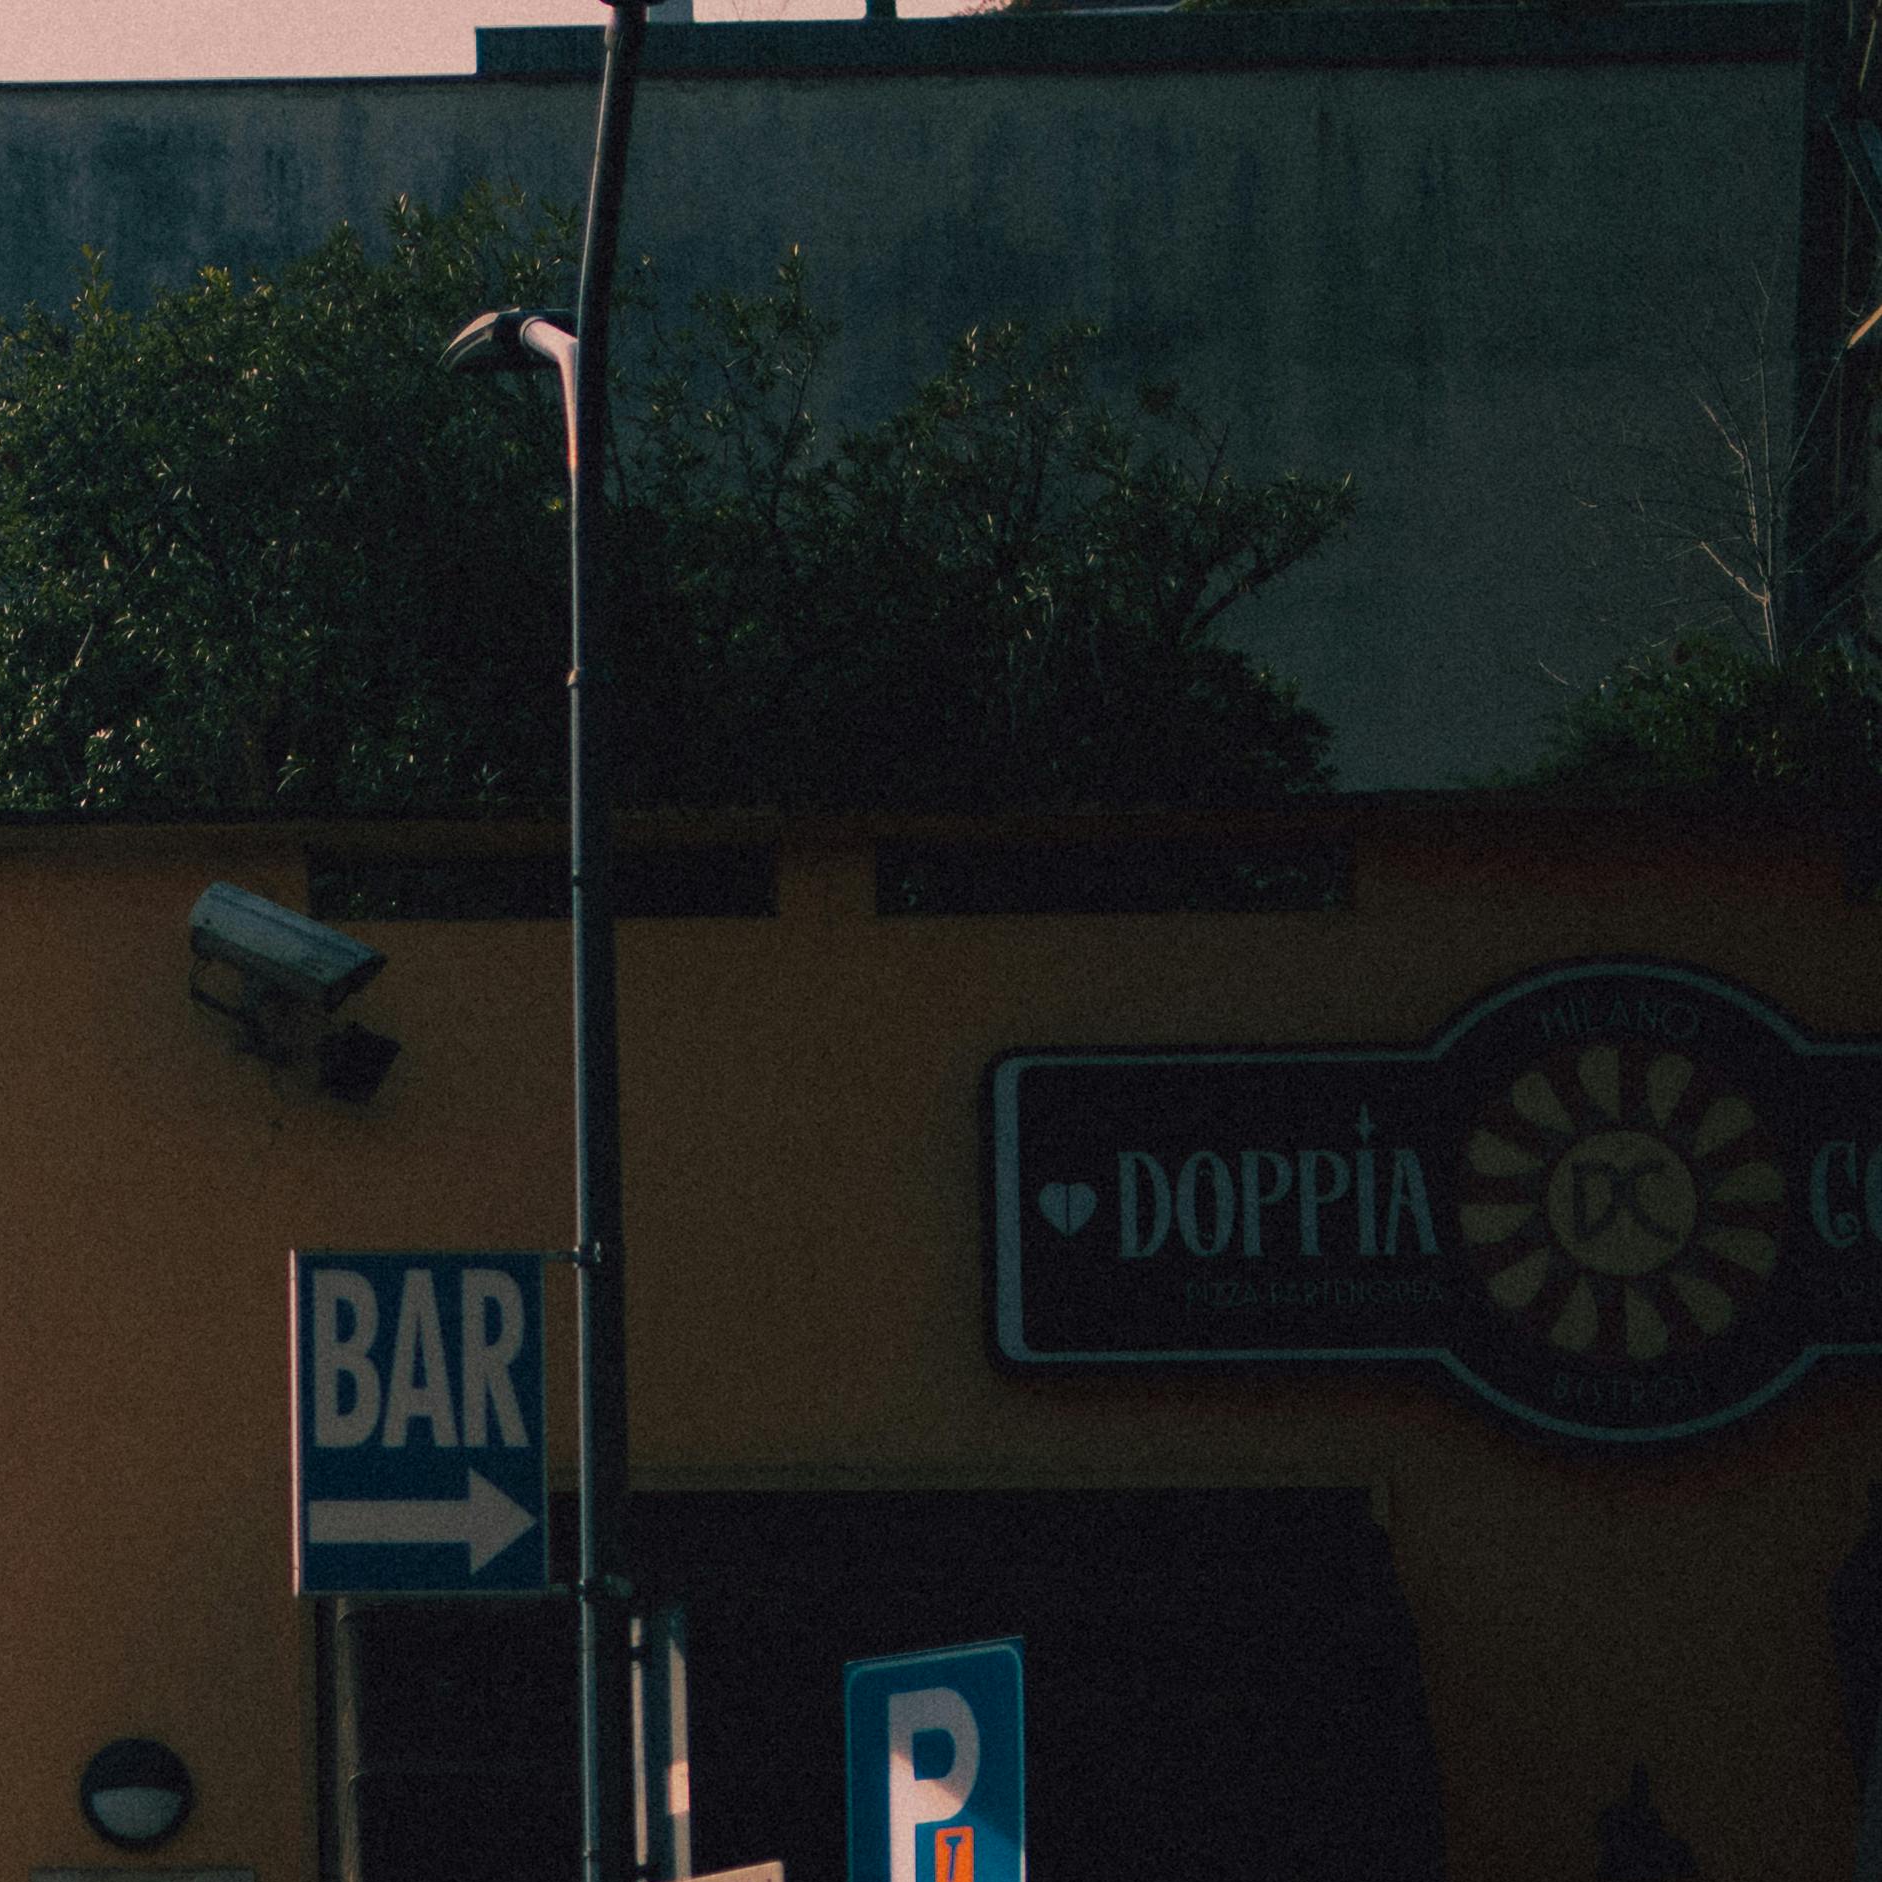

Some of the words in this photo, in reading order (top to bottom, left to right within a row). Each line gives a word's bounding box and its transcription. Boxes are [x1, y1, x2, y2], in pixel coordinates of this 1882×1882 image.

[1539, 996, 1700, 1041] MILANO
[1117, 1104, 1441, 1261] DOPPIA
[312, 1268, 530, 1448] BAR
